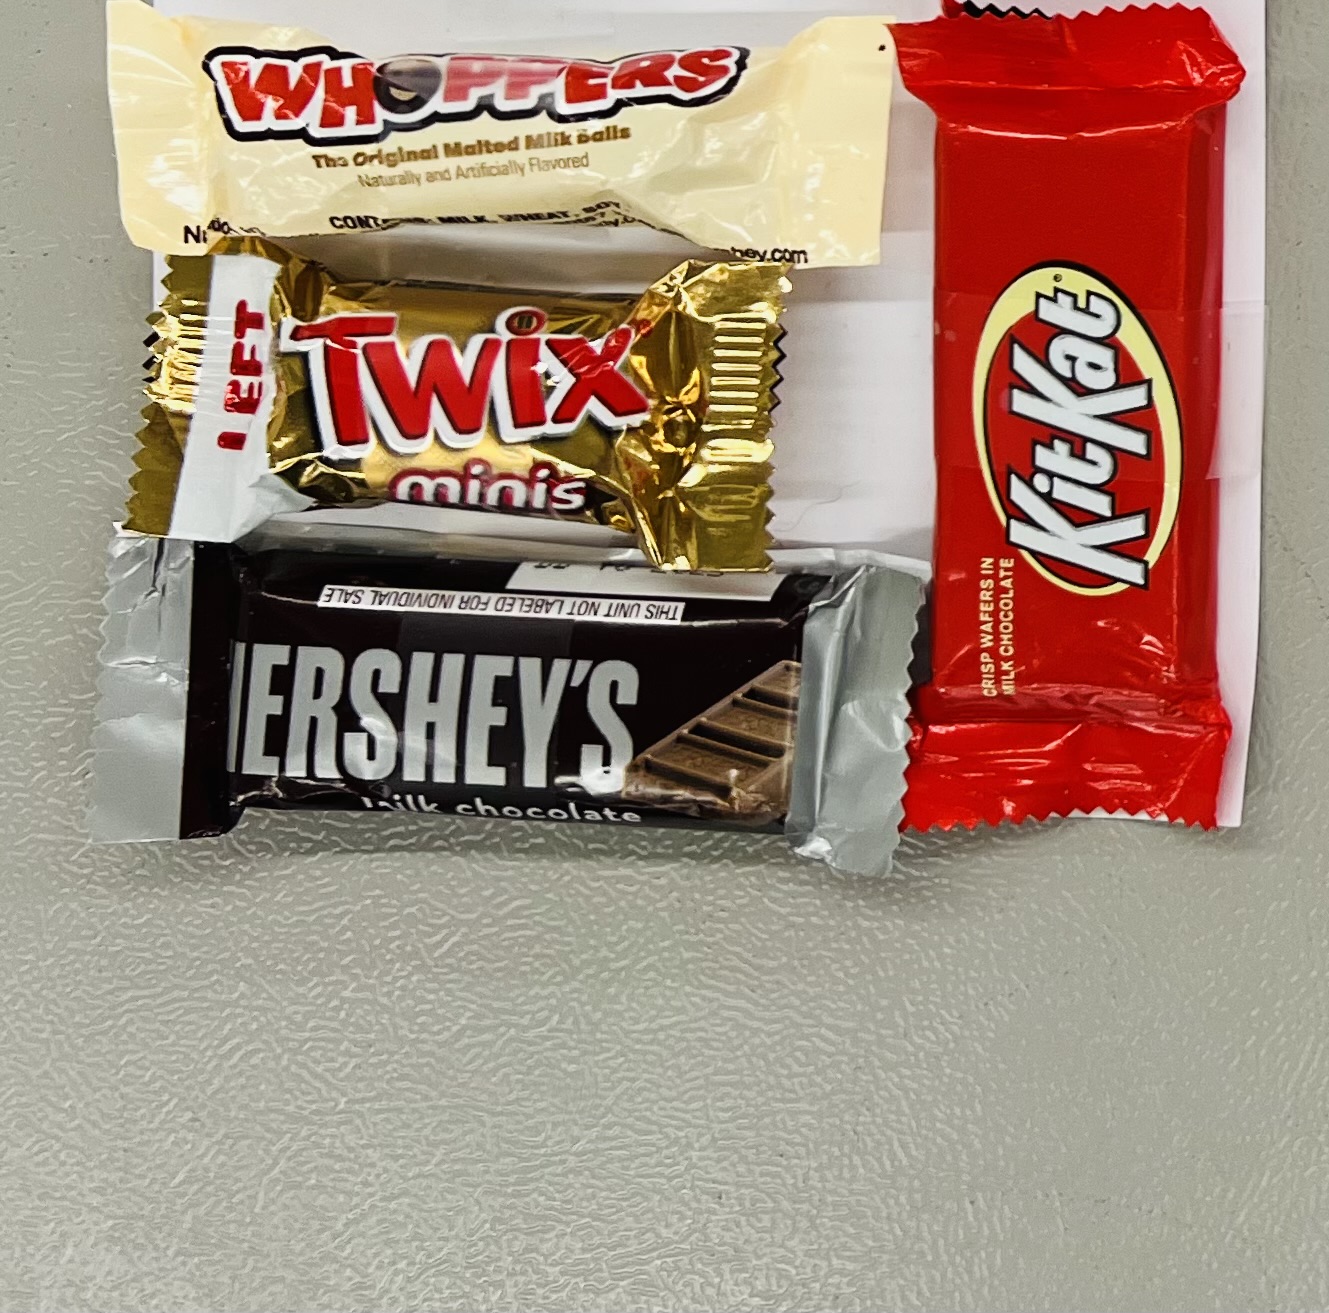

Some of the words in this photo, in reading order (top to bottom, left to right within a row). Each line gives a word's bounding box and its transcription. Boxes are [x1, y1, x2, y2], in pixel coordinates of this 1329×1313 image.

[210, 46, 742, 140] WHOPPERS
[312, 154, 347, 169] The
[353, 147, 438, 168] Original
[445, 137, 519, 158] Malted
[525, 131, 571, 149] Milk
[358, 167, 421, 188] Naturally
[426, 168, 450, 182] and
[455, 159, 526, 179] Artificially
[529, 152, 589, 173] Flavored
[280, 306, 653, 454] Twix
[392, 460, 589, 511] minis
[980, 557, 995, 575] IN
[323, 587, 365, 604] SALE
[371, 590, 455, 608] INDIVIDUAL
[458, 594, 491, 611] FOR
[494, 596, 563, 614] LABELED
[567, 599, 599, 616] NOT
[606, 601, 640, 619] UNIT
[999, 558, 1014, 657] CHOCOLATE
[646, 602, 678, 620] THIS
[979, 578, 995, 648] WAFERS
[980, 652, 998, 698] CRISP
[1000, 661, 1016, 696] MILK
[455, 798, 641, 824] chocolate
